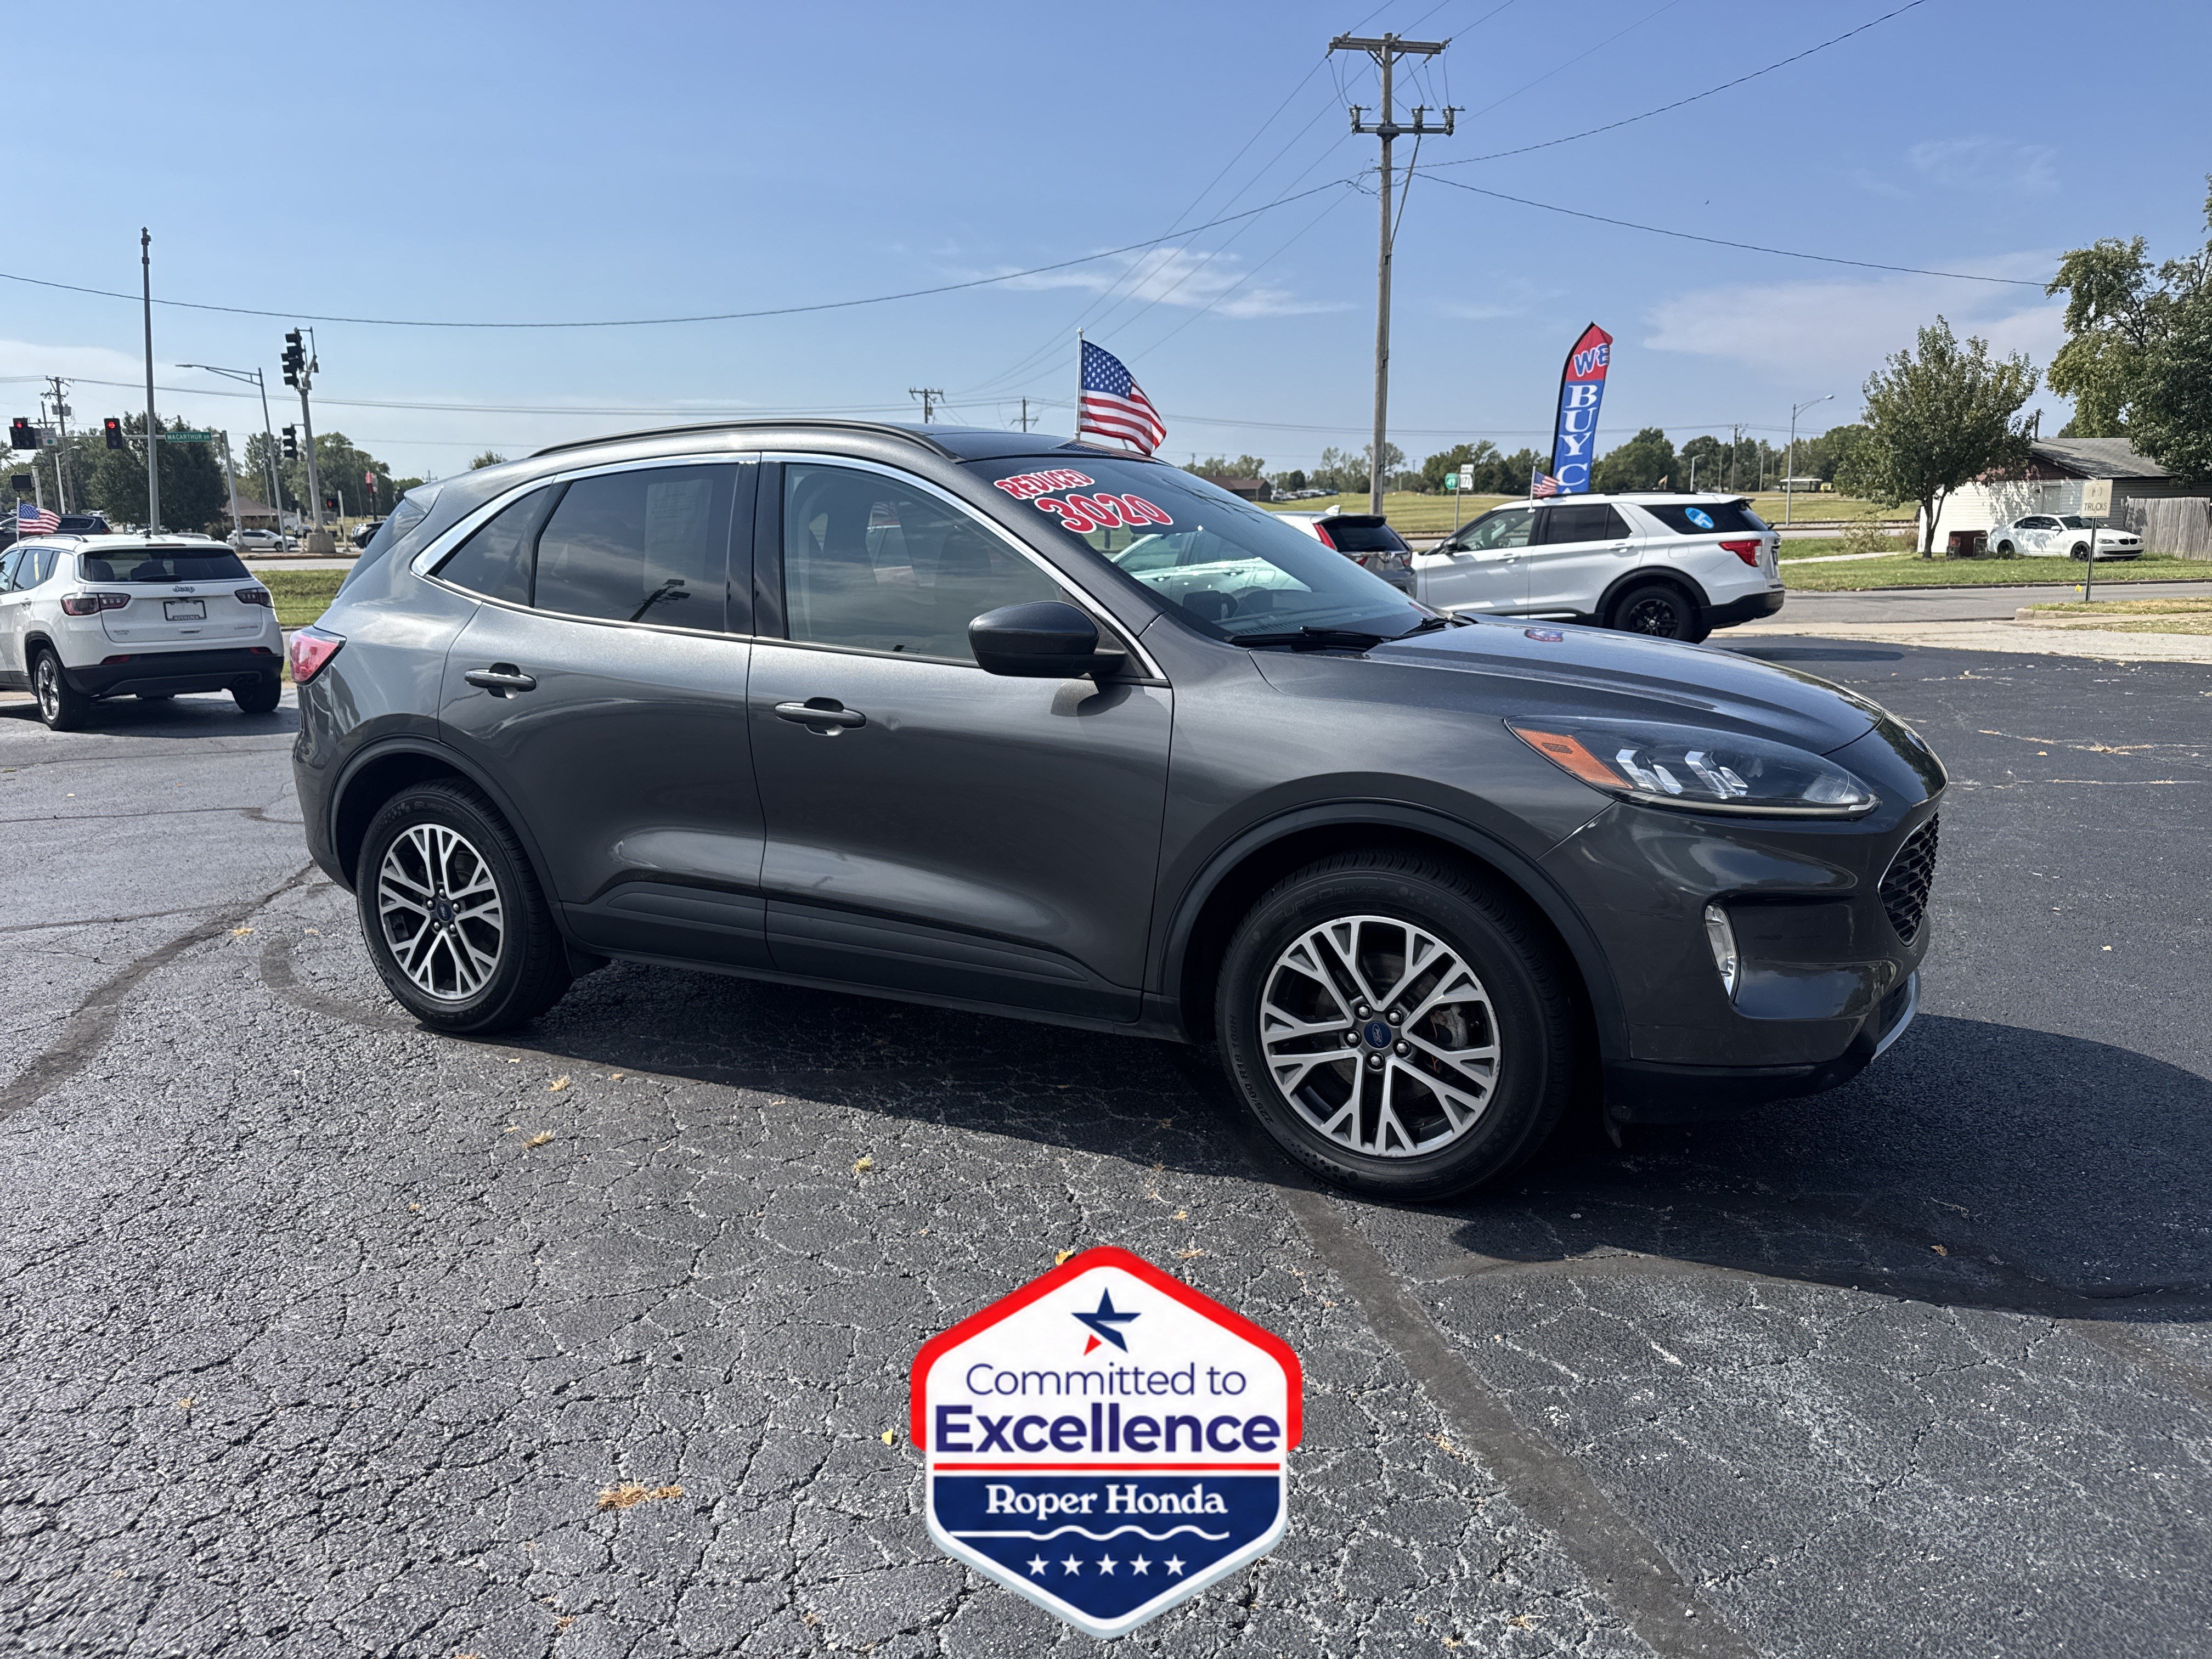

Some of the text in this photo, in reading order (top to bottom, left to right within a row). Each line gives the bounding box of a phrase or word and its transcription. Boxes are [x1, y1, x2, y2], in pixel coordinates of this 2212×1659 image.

[1573, 342, 1610, 377] WE
[1556, 385, 1598, 493] BUY C
[994, 469, 1095, 500] REDUCED
[1034, 493, 1174, 533] 3020
[2084, 502, 2108, 511] TRUCKS
[1244, 1082, 1274, 1124] 225/60
